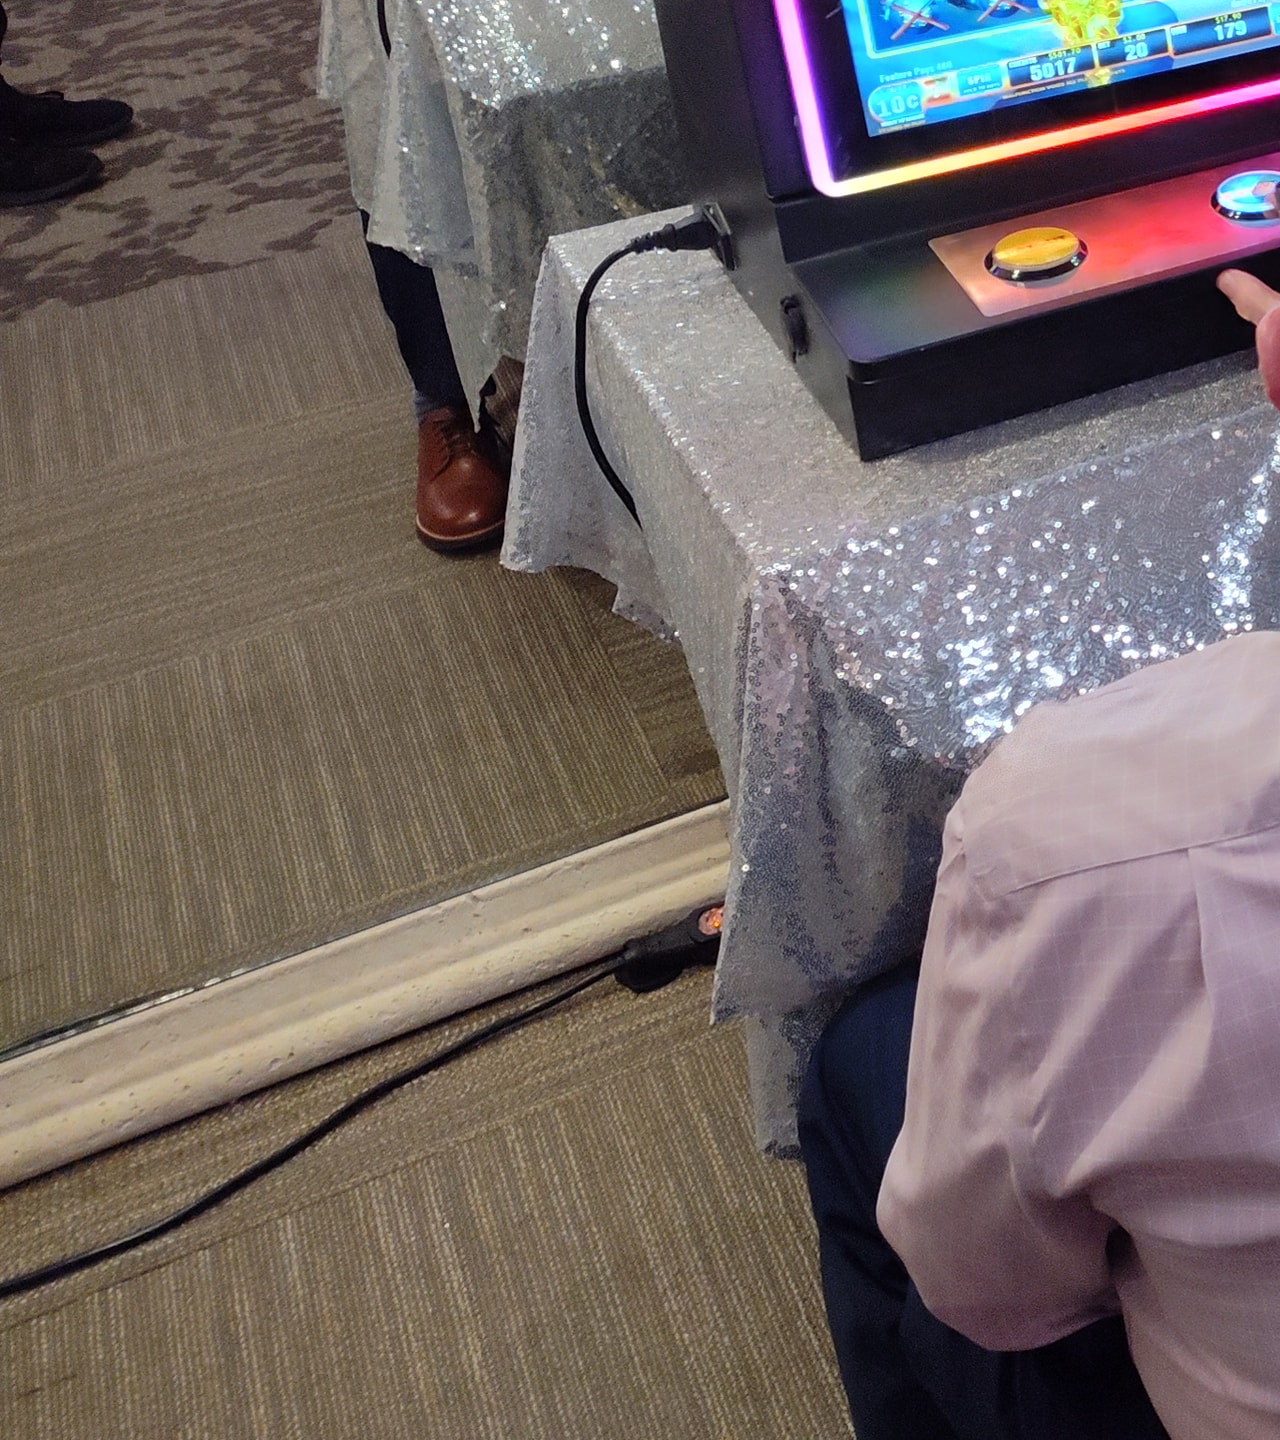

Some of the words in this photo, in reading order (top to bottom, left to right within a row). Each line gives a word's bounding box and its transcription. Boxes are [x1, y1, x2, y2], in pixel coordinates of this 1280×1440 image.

[1214, 21, 1247, 41] 179
[1125, 42, 1148, 60] 20
[1030, 58, 1077, 81] 5017
